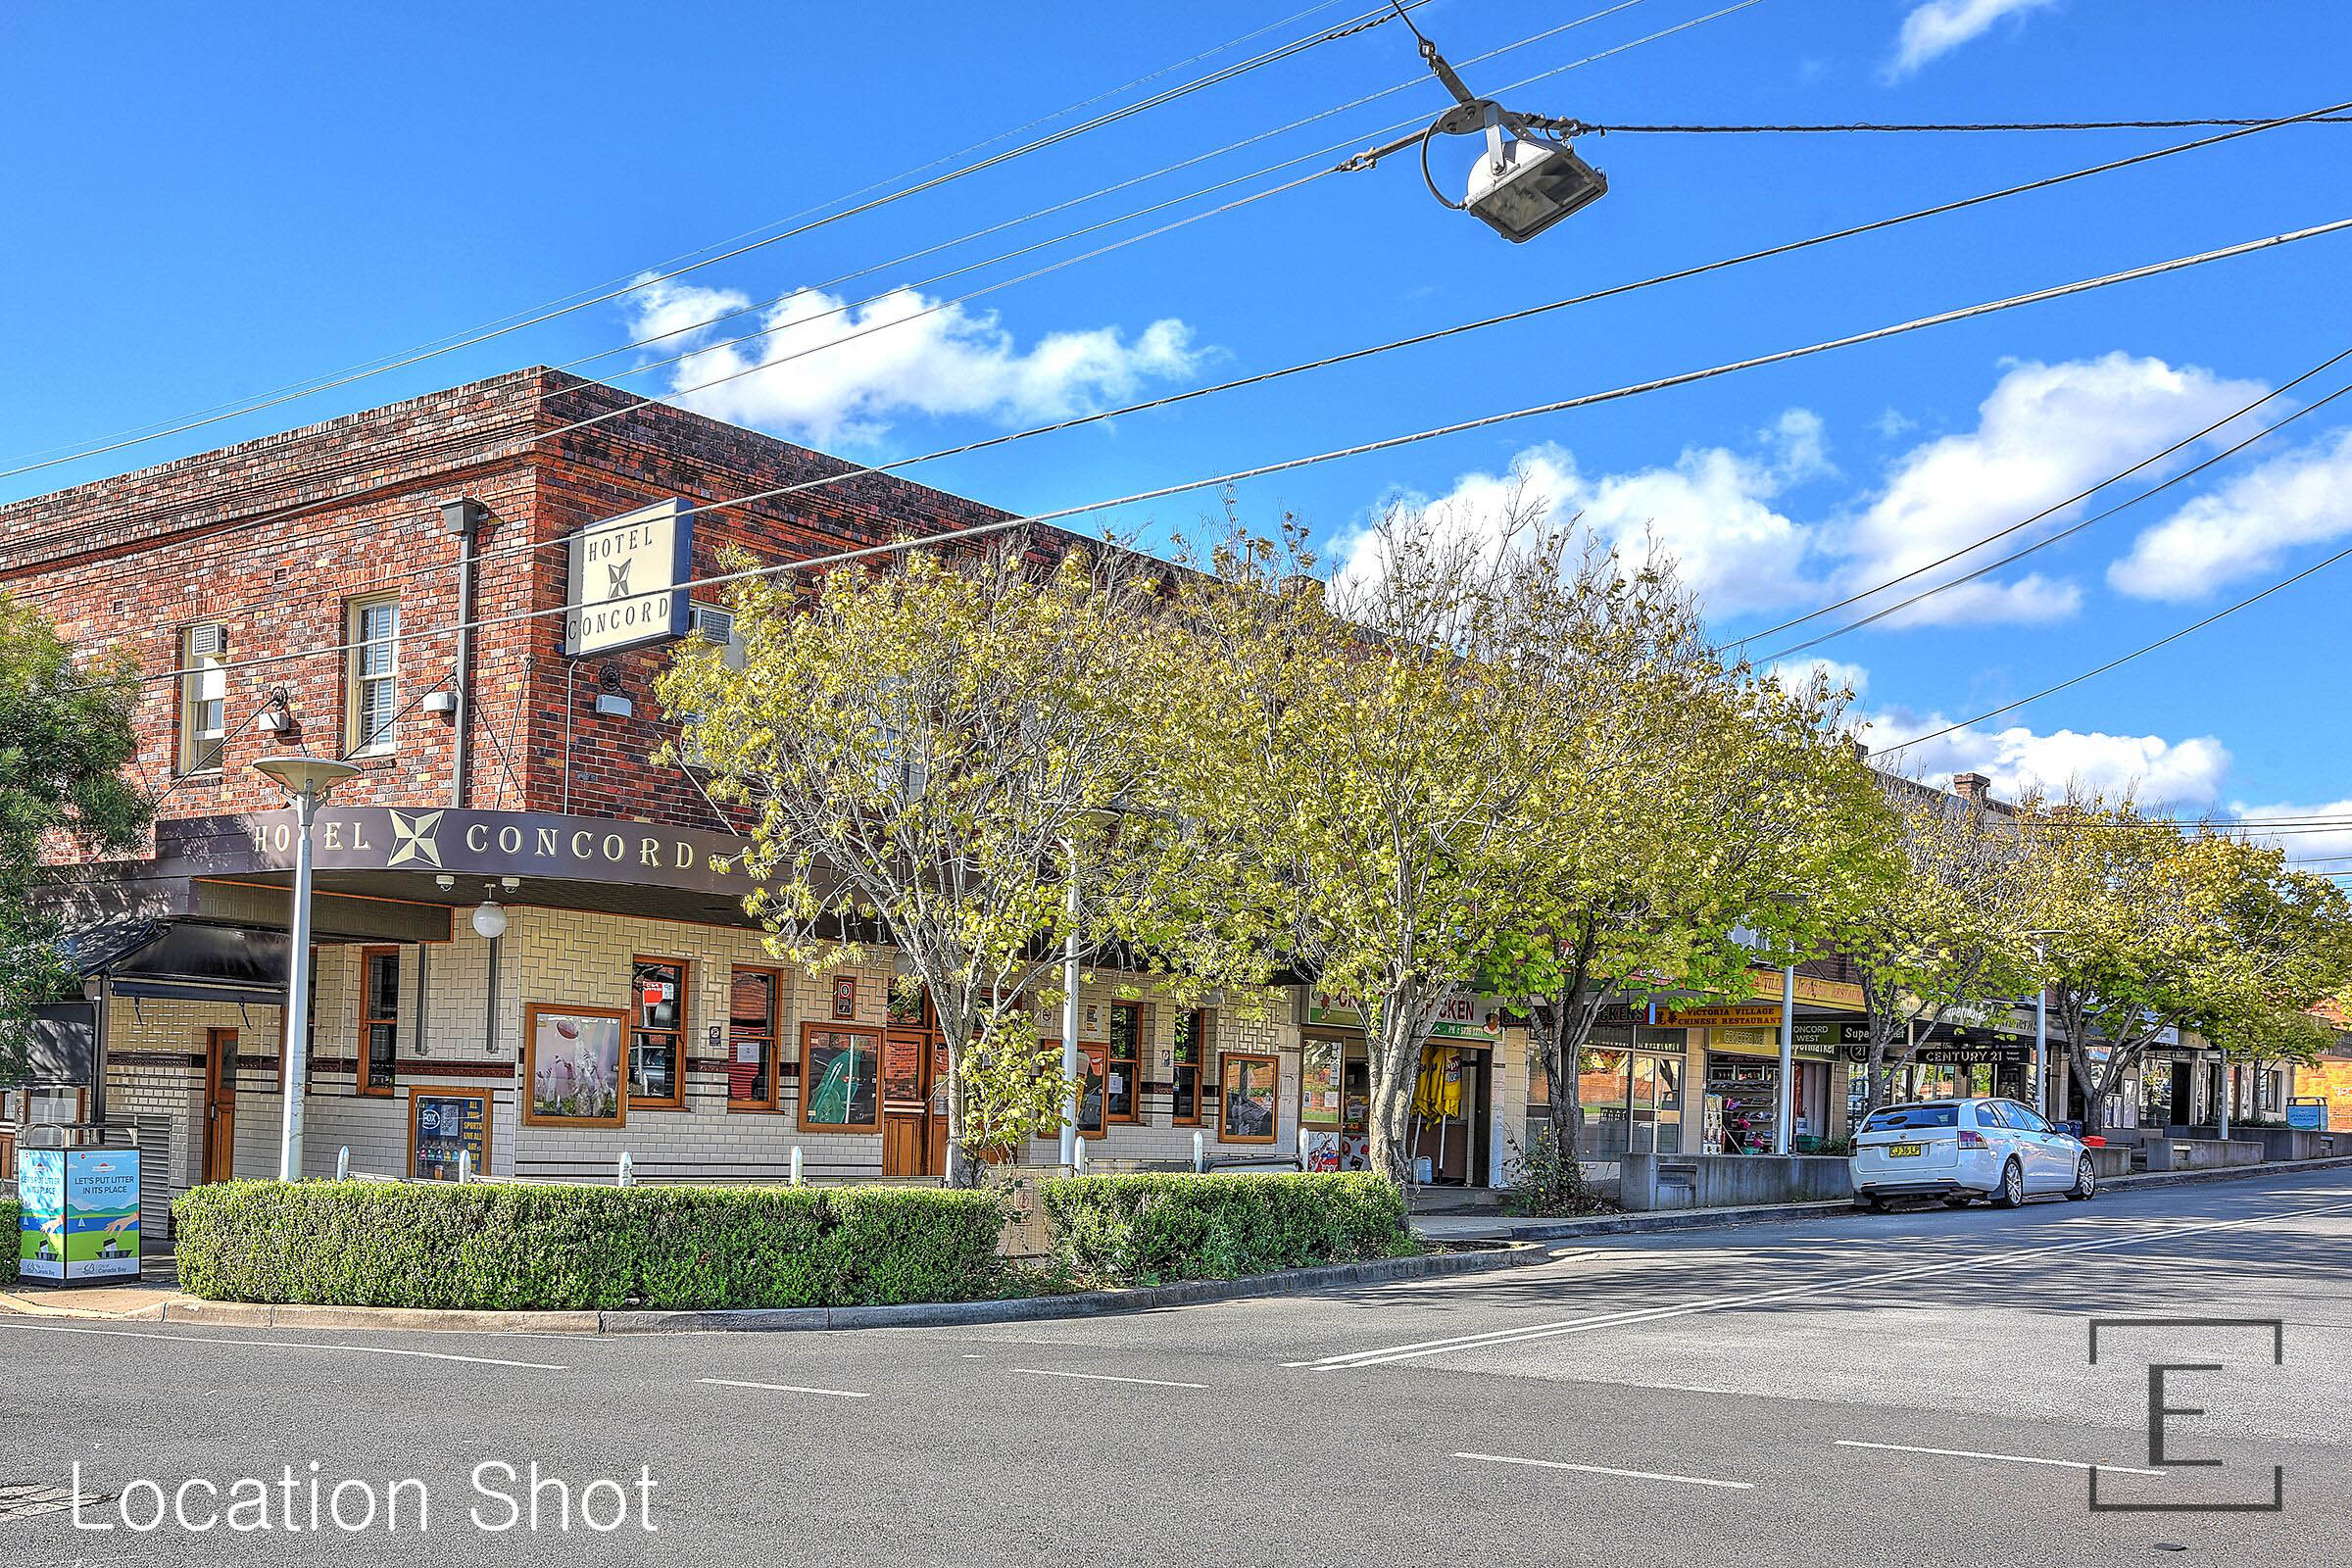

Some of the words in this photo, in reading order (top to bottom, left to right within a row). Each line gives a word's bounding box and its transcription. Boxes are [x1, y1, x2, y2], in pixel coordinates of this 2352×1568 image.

[588, 526, 653, 563] HOTEL
[567, 597, 668, 640] CONCORD
[254, 822, 372, 854] HOEL
[465, 823, 696, 871] CONCORD
[1677, 1017, 1717, 1026] CHINESE
[1722, 1016, 1783, 1025] RESTAURANT
[1792, 1025, 1829, 1034] ONCORD
[1854, 1046, 1866, 1056] 21
[1926, 1051, 1987, 1062] CENTURY
[1989, 1051, 2002, 1061] 21
[422, 1113, 436, 1123] FOX
[74, 1176, 94, 1185] LET'S
[95, 1176, 110, 1185] PUT
[111, 1175, 135, 1184] LITTER
[91, 1186, 104, 1195] ITS
[105, 1185, 127, 1194] PLACE
